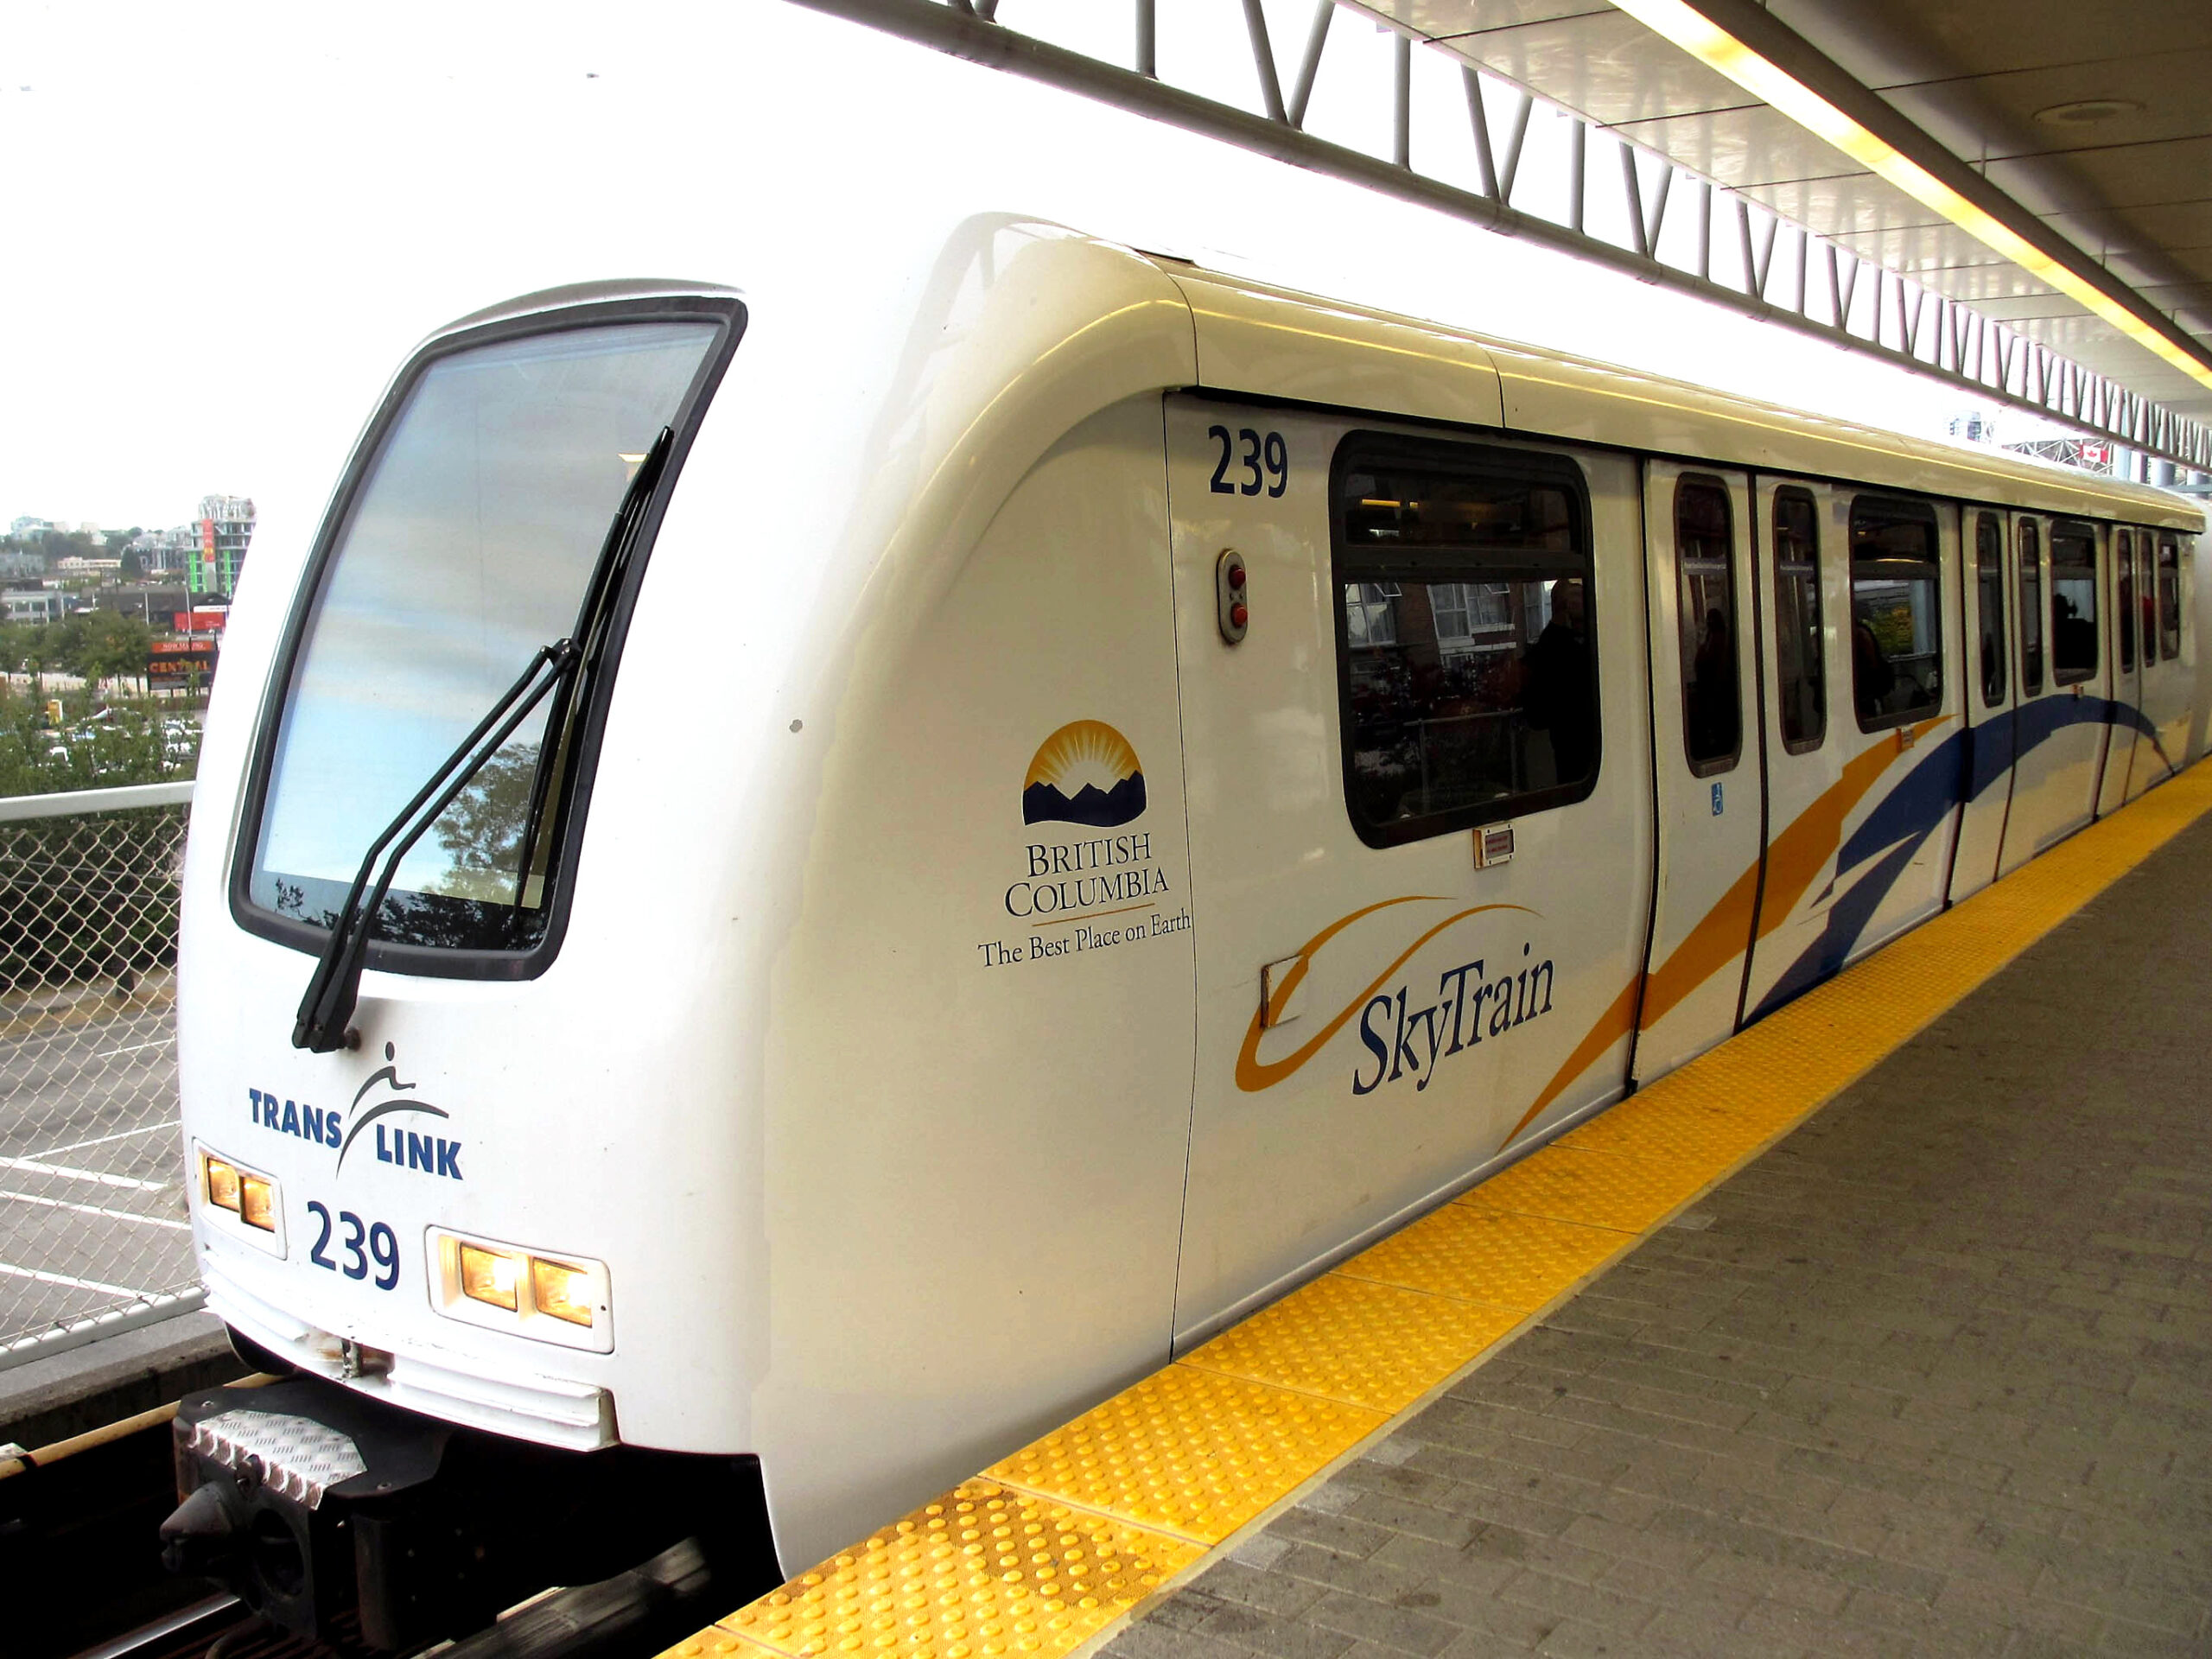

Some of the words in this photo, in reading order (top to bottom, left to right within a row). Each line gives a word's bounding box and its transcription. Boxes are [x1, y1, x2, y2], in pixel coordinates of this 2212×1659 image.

[1208, 425, 1287, 499] 239
[1004, 866, 1169, 918] COLUMBIA
[1026, 832, 1152, 878] BRITISH
[977, 941, 1023, 968] The
[1028, 936, 1070, 961] Best
[1075, 925, 1121, 951] Place
[1125, 923, 1147, 942] on
[1150, 907, 1192, 938] Earth
[1351, 941, 1555, 1096] SkyTrain
[248, 1087, 343, 1149] TRANS
[376, 1124, 464, 1181] LINK
[307, 1200, 400, 1291] 239
